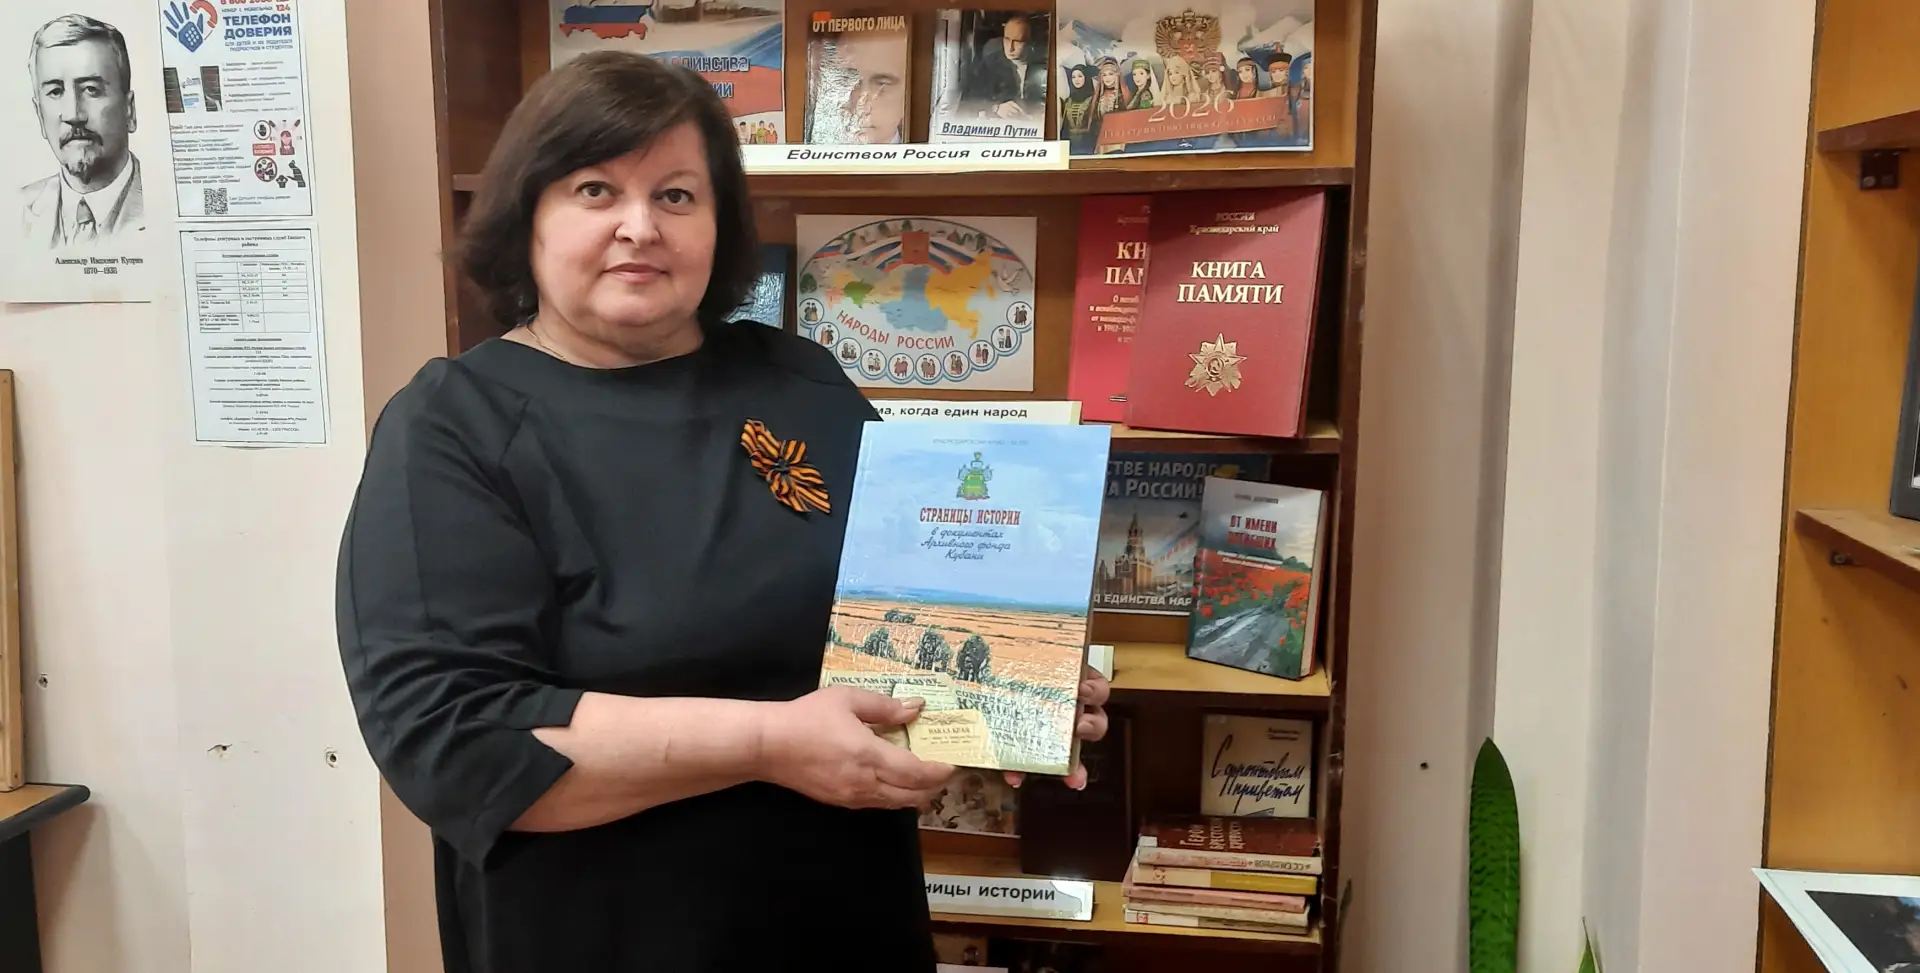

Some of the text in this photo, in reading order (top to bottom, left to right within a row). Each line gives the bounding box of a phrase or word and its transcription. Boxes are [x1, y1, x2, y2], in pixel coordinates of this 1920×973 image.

[223, 13, 291, 26] ТЕЛЕФОН
[828, 17, 875, 32] ПЕРВОГО
[875, 15, 905, 31] ЛИЦА
[224, 26, 292, 40] ДОВЕРИЯ
[942, 121, 1038, 138] Владимир Путин
[787, 147, 1048, 160] Единством Россия сильна
[1191, 261, 1266, 279] КНИГА
[1177, 283, 1284, 304] ПАМЯТИ
[836, 310, 955, 350] НАРОДЫ РОССИИ
[900, 407, 939, 416] когда
[944, 408, 979, 418] един
[983, 408, 1028, 418] народ
[919, 507, 1021, 526] СТРАНИЦЫ ИСТОРИИ
[1230, 514, 1278, 533] ОТ ИМЕНИ
[931, 526, 1004, 539] в документах
[920, 536, 1011, 552] Архивного фонда
[945, 548, 985, 561] Кубани
[1104, 594, 1166, 606] ЕДИНСТВА
[1211, 734, 1305, 797] С фронтовым
[1231, 780, 1305, 814] приветом
[978, 884, 1055, 902] истории
